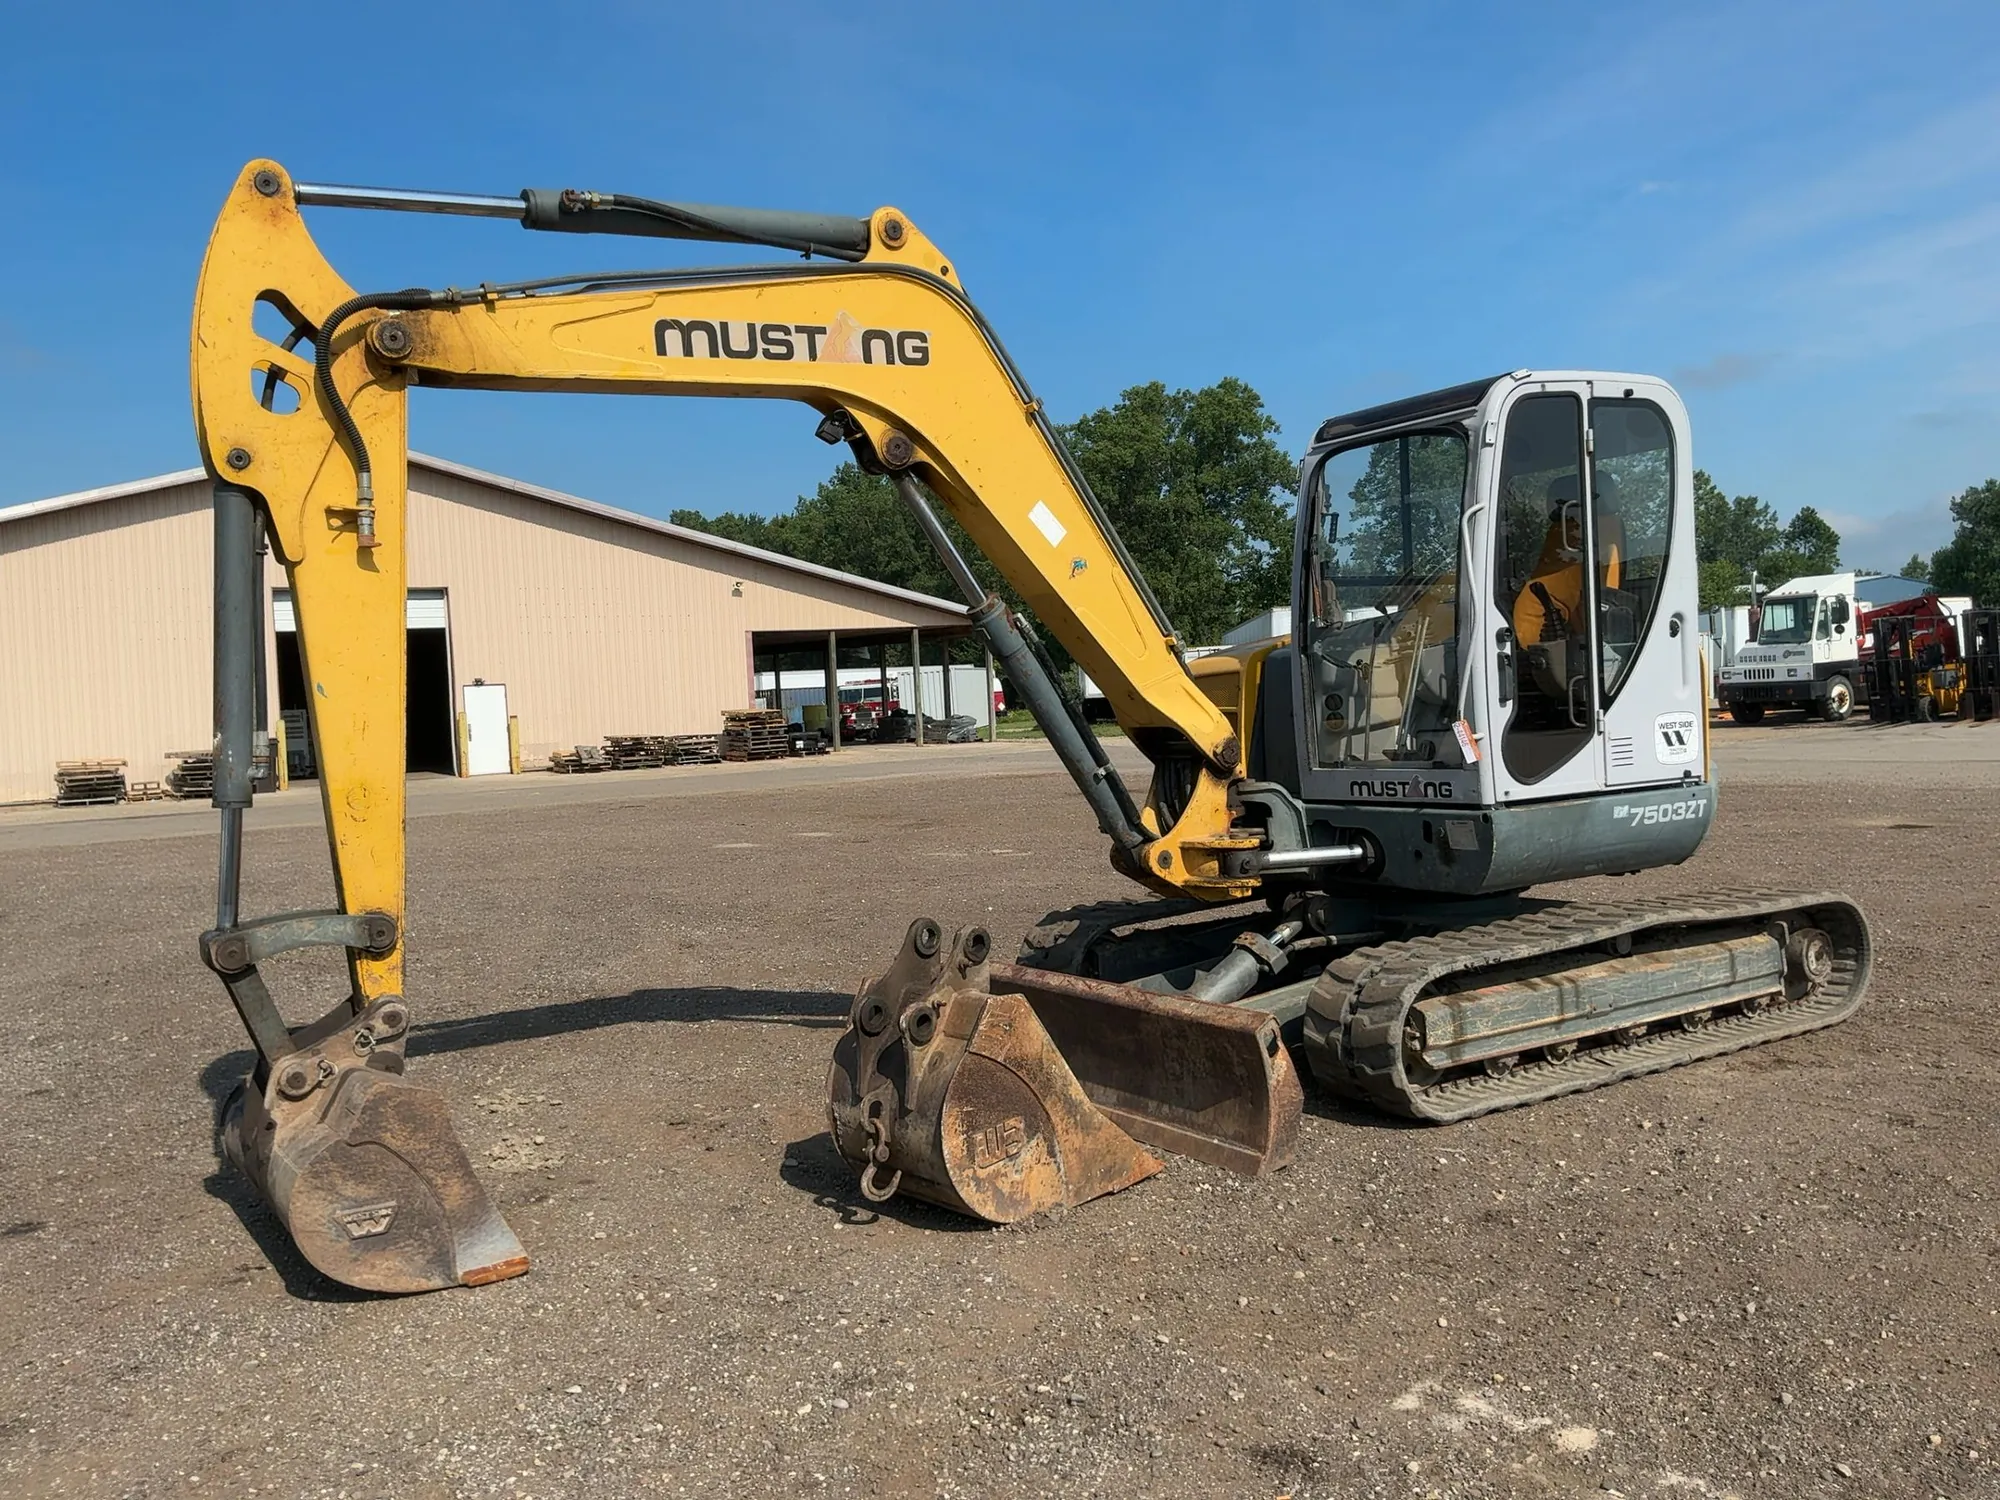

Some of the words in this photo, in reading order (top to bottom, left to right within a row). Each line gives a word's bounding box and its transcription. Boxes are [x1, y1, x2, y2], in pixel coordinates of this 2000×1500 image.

[654, 311, 930, 366] MUSTANG
[1658, 721, 1677, 730] WEST
[1678, 720, 1694, 729] SIDE
[1350, 774, 1453, 798] MUSTANG
[1630, 799, 1707, 827] 7503ZT
